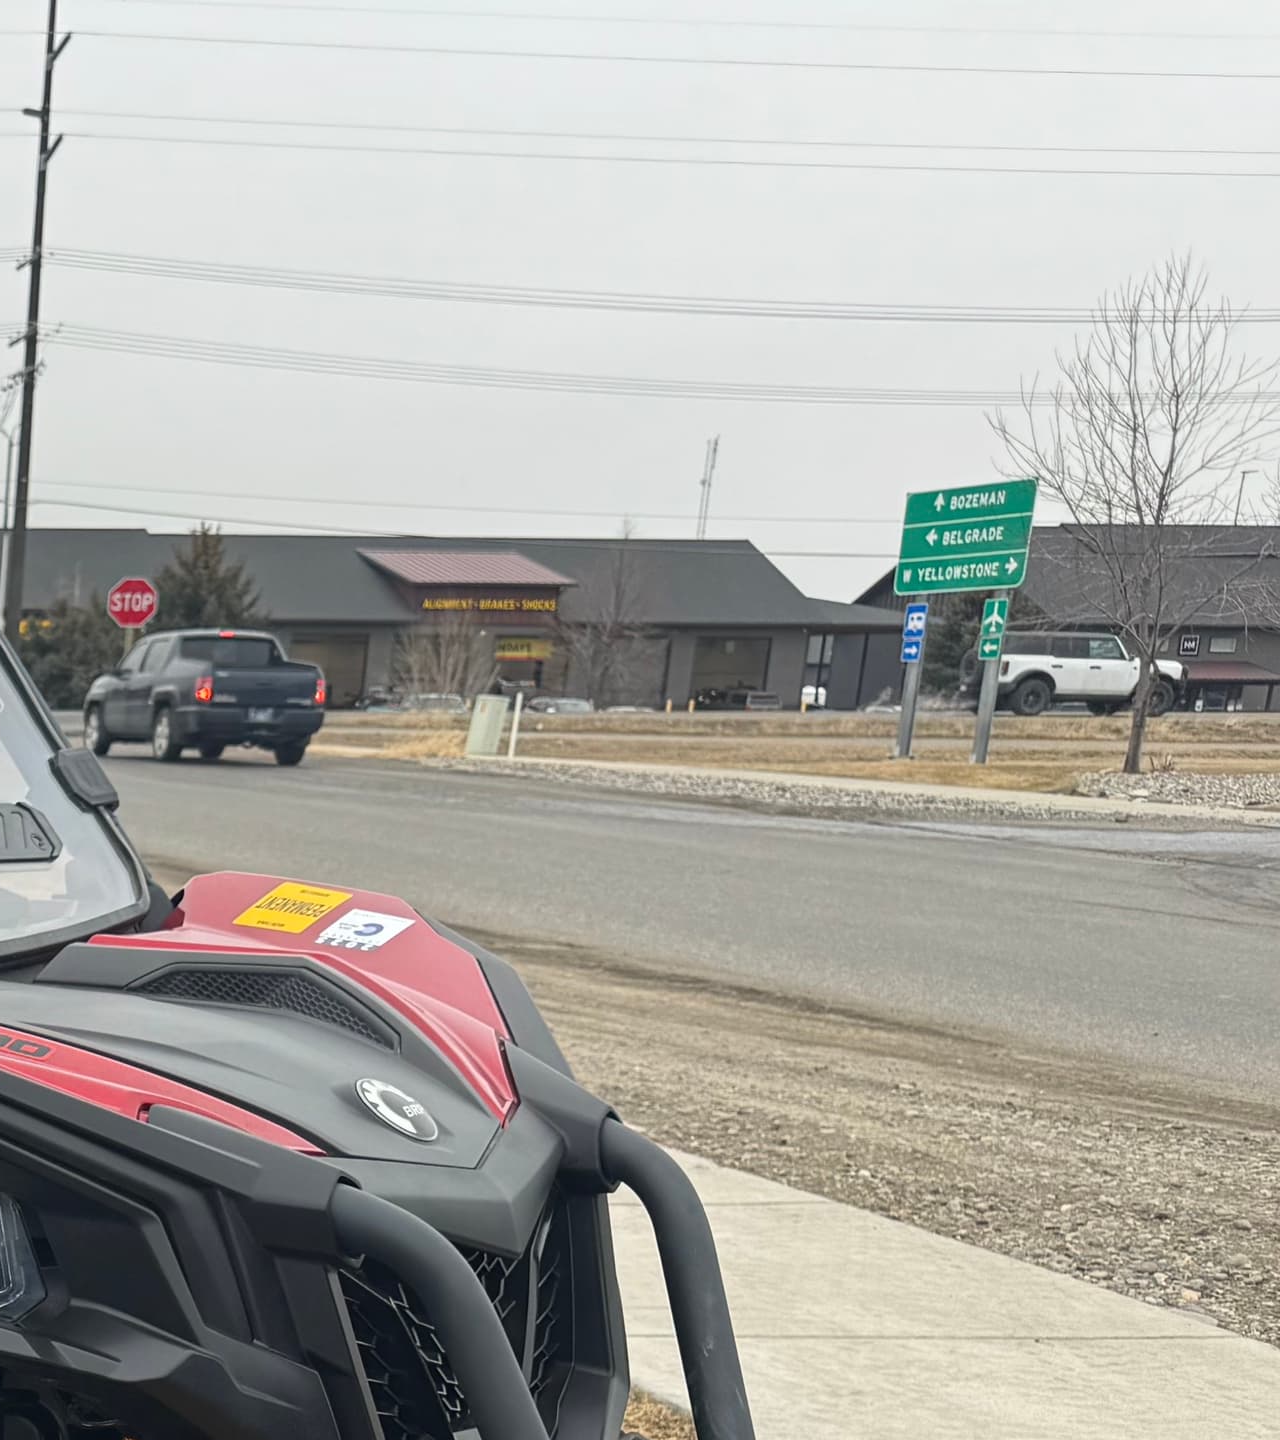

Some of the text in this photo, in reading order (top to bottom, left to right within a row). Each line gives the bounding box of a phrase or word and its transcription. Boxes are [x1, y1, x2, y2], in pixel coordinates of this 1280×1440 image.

[950, 490, 1007, 511] BOZEMAN
[942, 526, 1005, 546] BELGRADE
[903, 561, 1000, 584] W YELLOWSTONE
[110, 592, 154, 613] STOP
[479, 598, 516, 612] BRAKES
[522, 598, 557, 612] SHOCKS
[254, 895, 331, 918] PERMANENT
